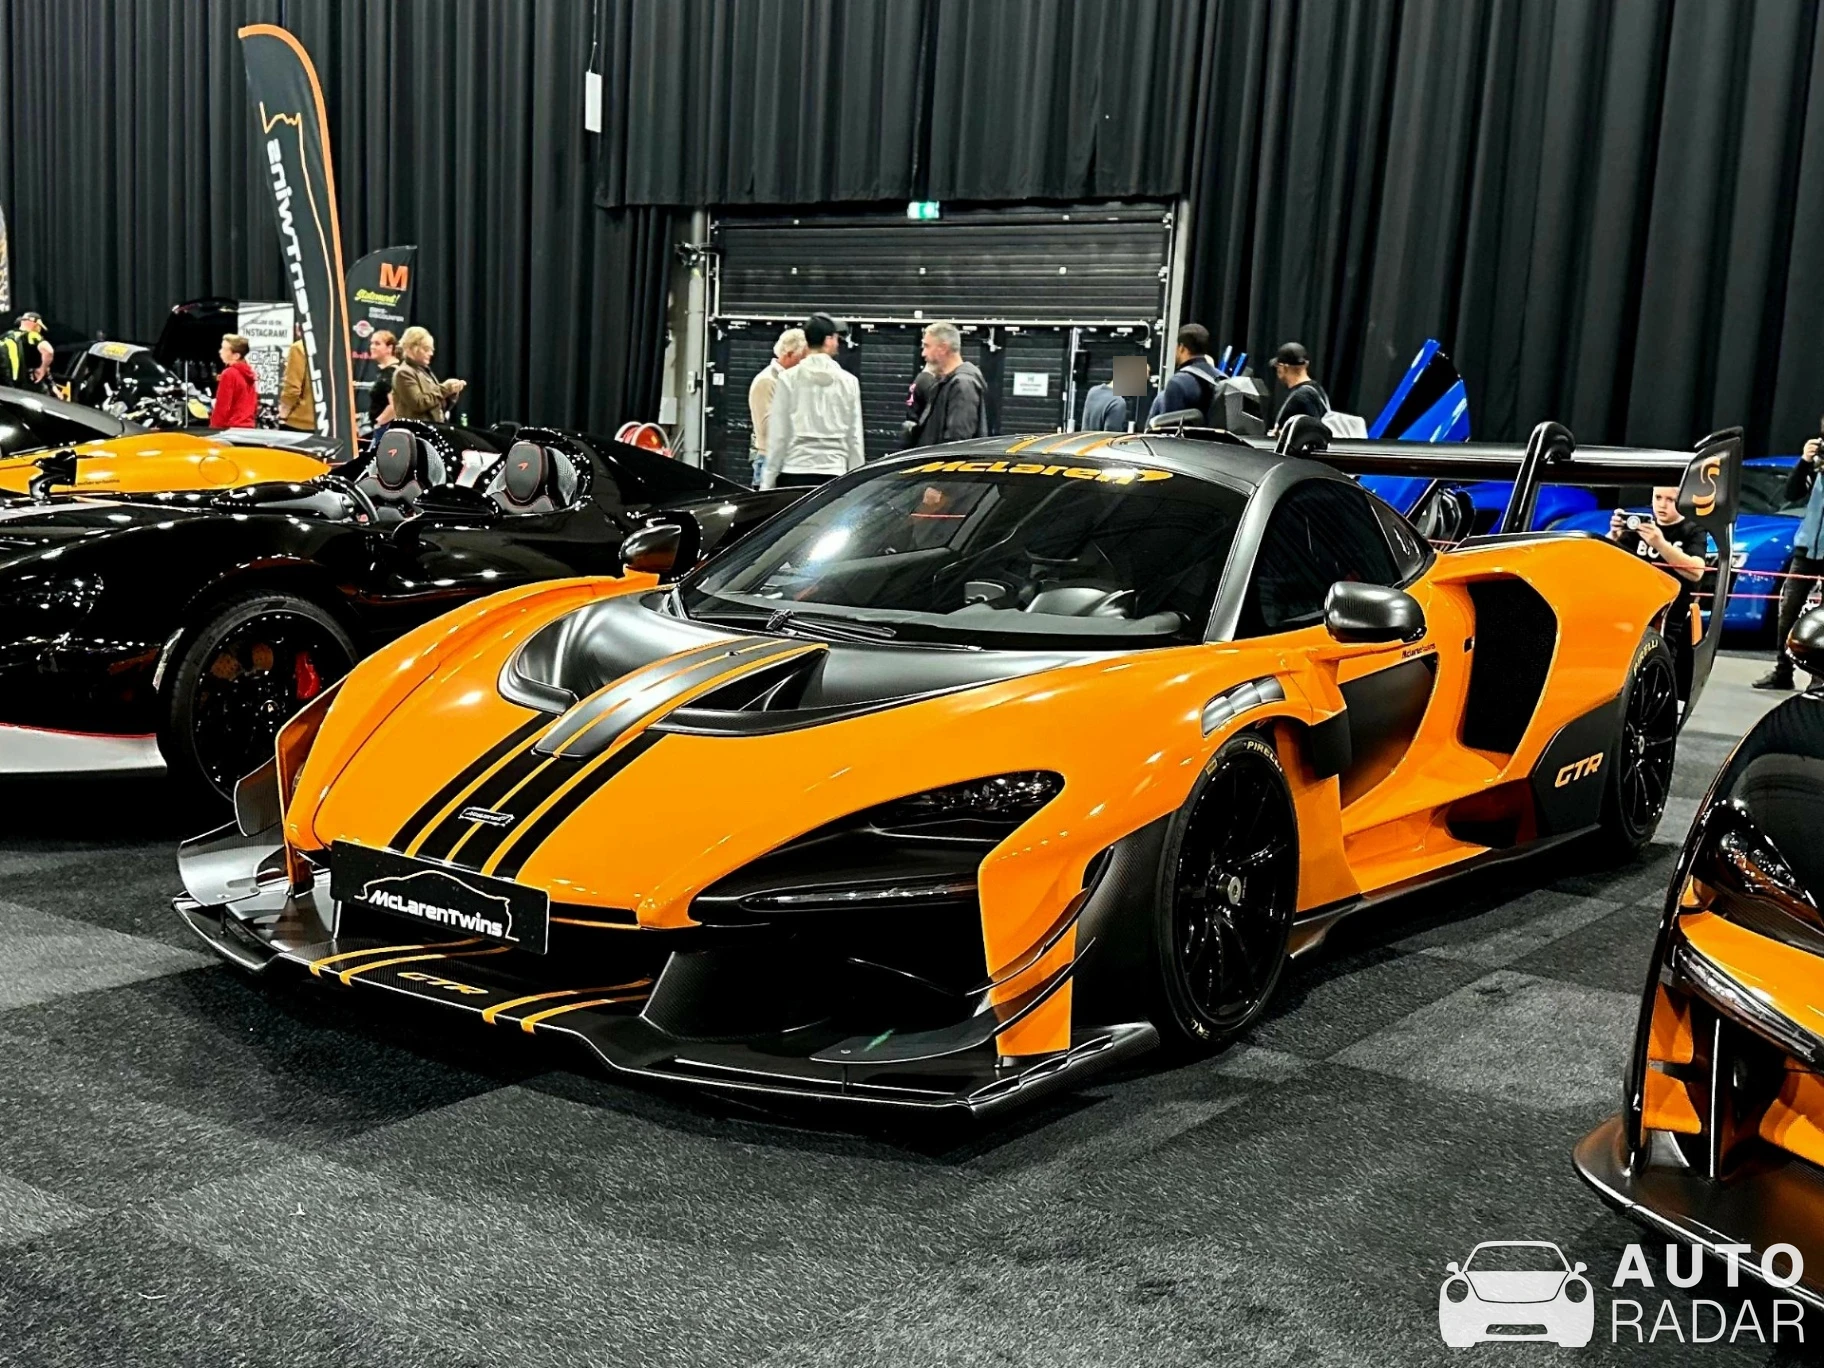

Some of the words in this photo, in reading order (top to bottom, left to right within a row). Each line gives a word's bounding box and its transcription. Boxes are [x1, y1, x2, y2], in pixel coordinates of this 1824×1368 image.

[380, 262, 409, 291] M
[899, 461, 1138, 485] McLaren
[1633, 638, 1659, 678] PIRELLI
[1246, 740, 1283, 773] PIRELL
[1554, 752, 1604, 788] GTR
[368, 889, 503, 937] McLarenTwins
[397, 972, 489, 995] GTR
